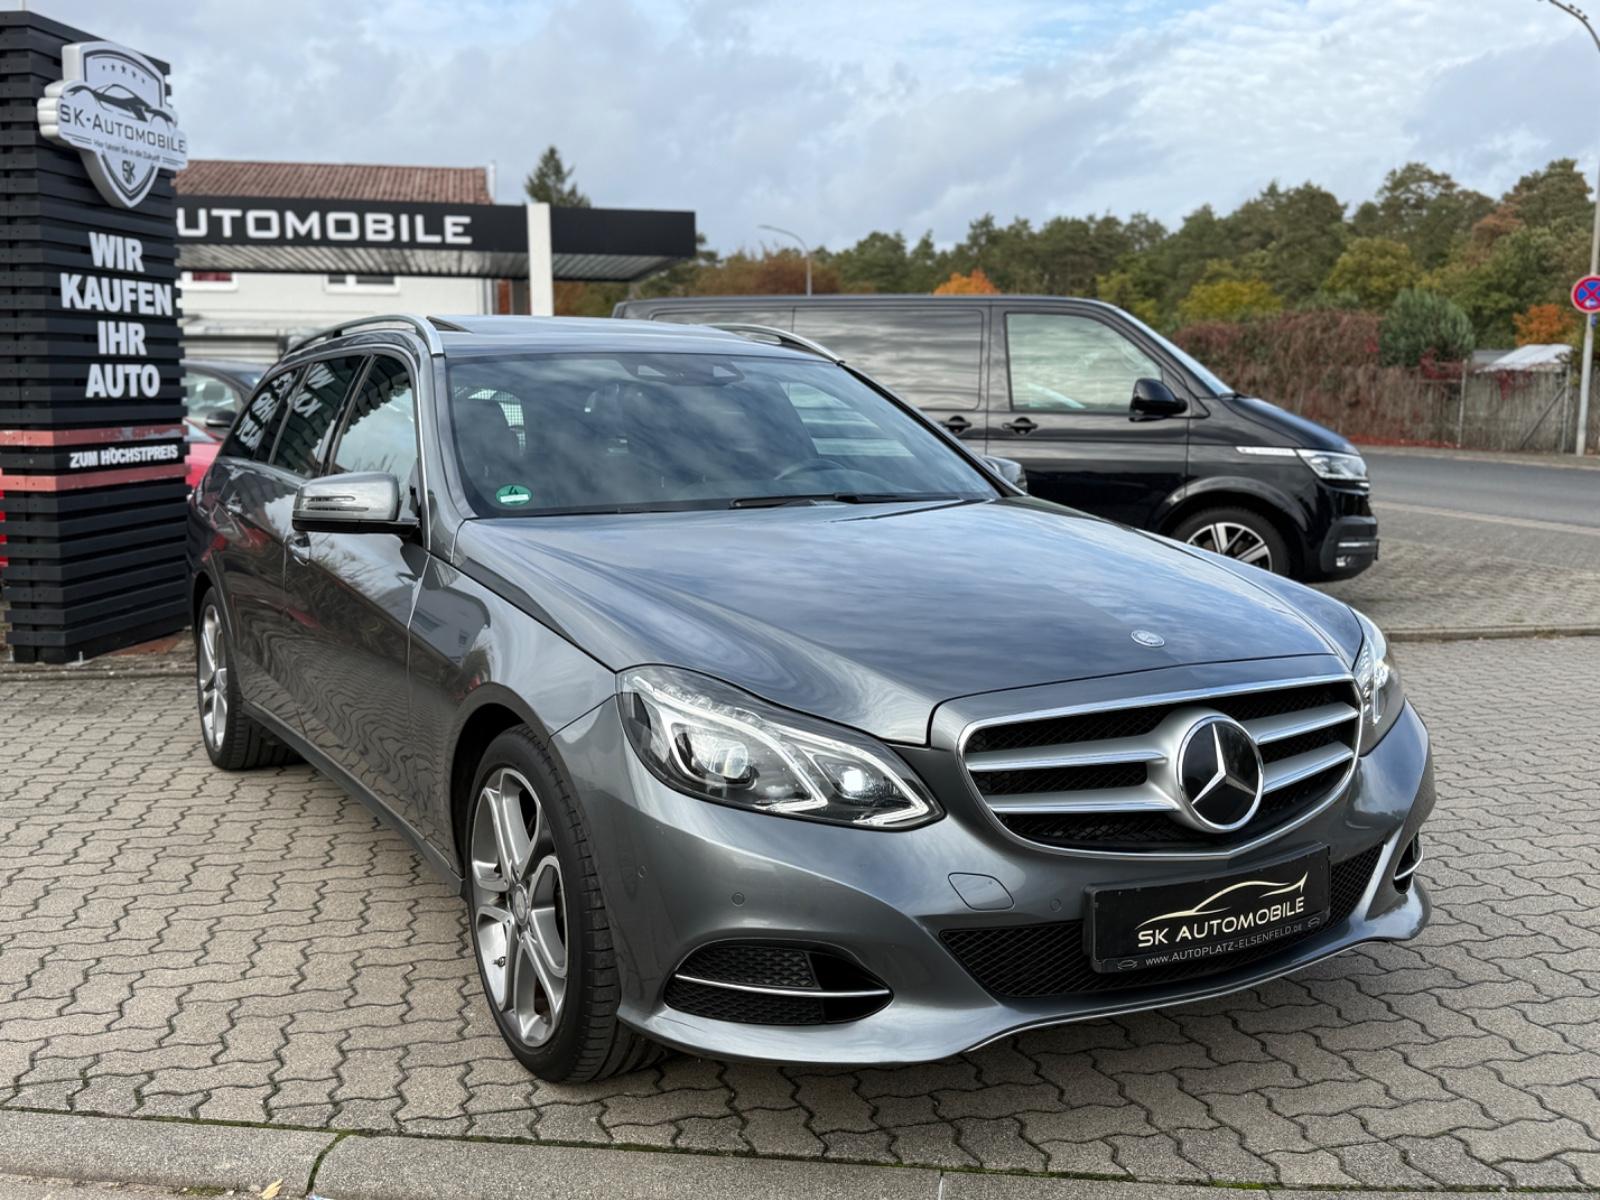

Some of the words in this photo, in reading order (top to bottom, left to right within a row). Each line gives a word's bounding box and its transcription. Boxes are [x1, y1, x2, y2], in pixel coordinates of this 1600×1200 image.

[59, 103, 186, 155] SK-AUTOMOBILE
[88, 232, 145, 272] WIR
[60, 273, 173, 316] KAUFEN
[97, 321, 147, 355] IHR
[85, 364, 160, 398] AUTO
[69, 451, 98, 468] ZUM
[101, 444, 178, 466] HÖCHSTPREIS
[1137, 927, 1170, 948] SK
[1175, 896, 1305, 942] AUTOMOBILE
